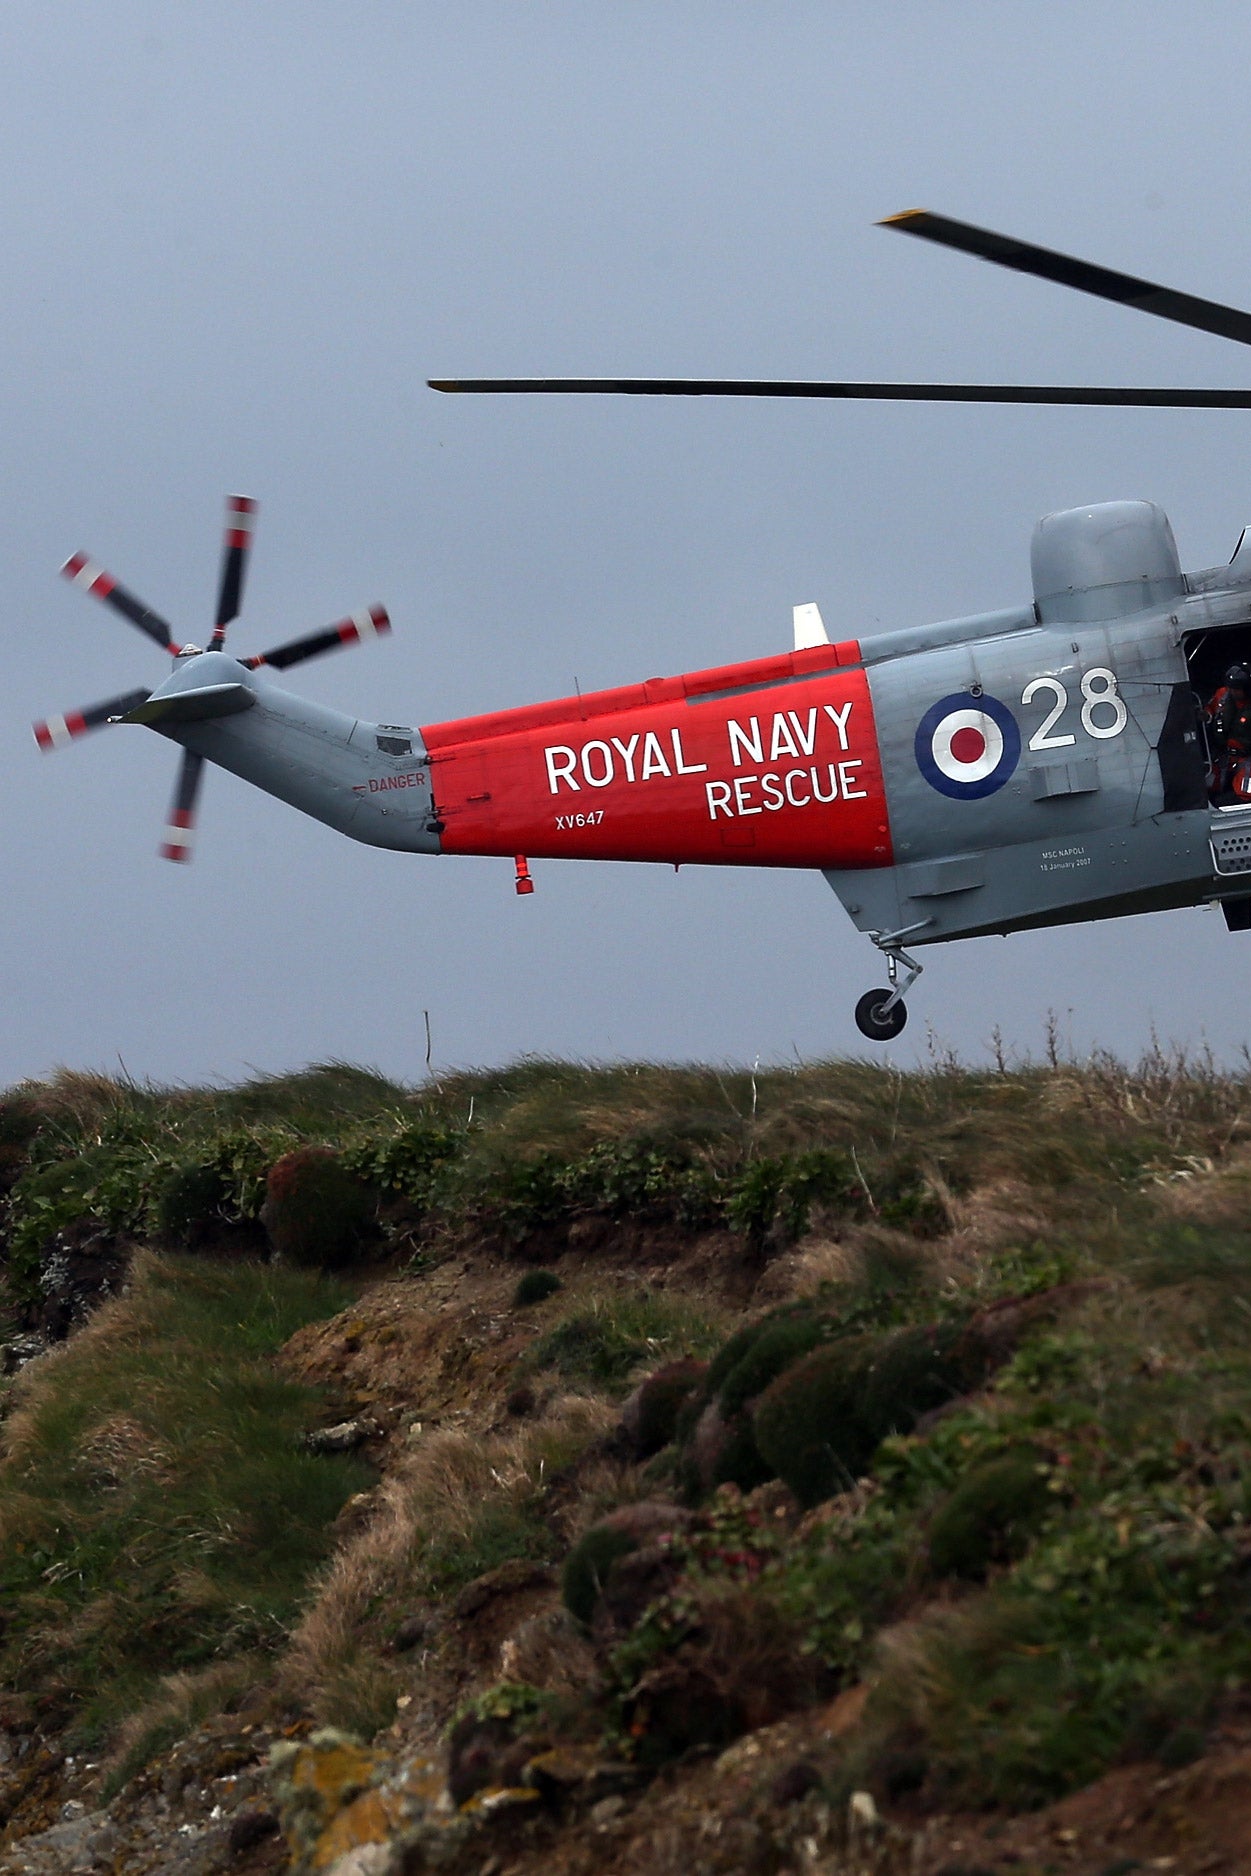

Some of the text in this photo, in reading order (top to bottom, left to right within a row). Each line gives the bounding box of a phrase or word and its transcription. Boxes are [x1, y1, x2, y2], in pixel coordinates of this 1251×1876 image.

[1021, 666, 1128, 752] 28
[543, 701, 854, 795] ROYAL NAVY
[368, 772, 425, 793] DANGER
[704, 759, 868, 821] RESCUE
[554, 810, 605, 831] XV647
[1058, 847, 1085, 857] NAPOLI
